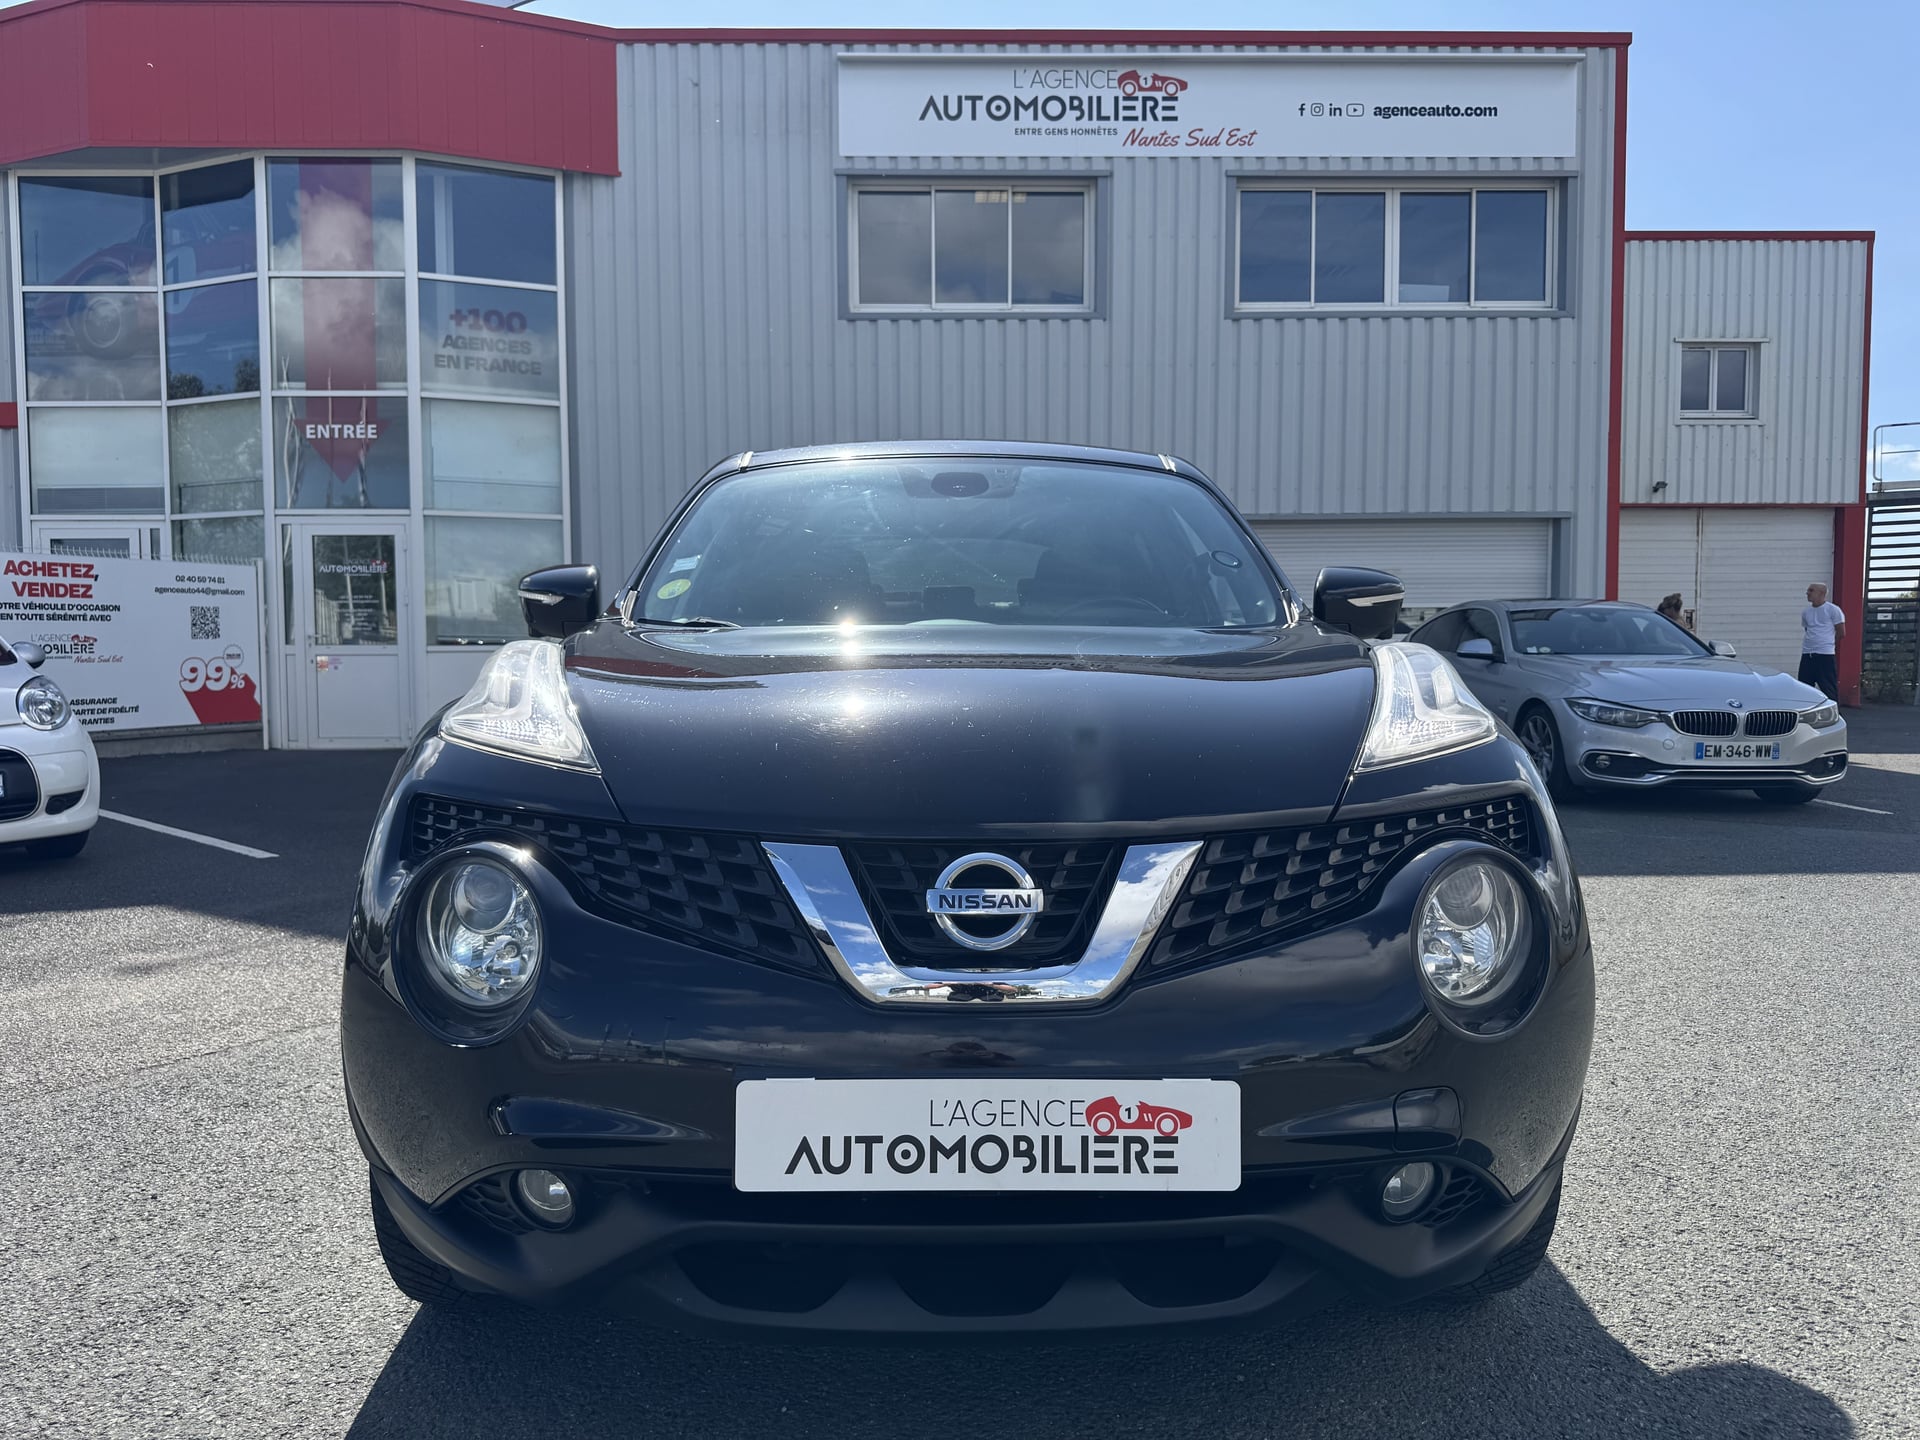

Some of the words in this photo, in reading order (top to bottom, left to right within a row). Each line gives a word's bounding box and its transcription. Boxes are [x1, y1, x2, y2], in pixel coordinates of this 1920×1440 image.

[1013, 69, 1118, 89] L'AGENCE
[1373, 105, 1498, 119] agenceauto.com
[1014, 127, 1042, 136] ENTRE
[1044, 127, 1068, 136] GENS
[1070, 125, 1118, 136] HONNÊTES
[1122, 128, 1180, 148] Nantes
[1185, 128, 1224, 147] Sud
[1225, 128, 1258, 147] Est
[449, 308, 527, 335] +100
[442, 334, 533, 355] AGENCES
[434, 354, 460, 370] EN
[464, 355, 542, 376] FRANCE
[305, 420, 378, 439] ENTRÉE
[11, 581, 93, 599] VENDEZ
[154, 587, 245, 596] agenceauto44@gmail.com
[21, 601, 67, 612] VÉHICULE
[67, 603, 121, 613] D'OCCASION
[14, 613, 45, 621] TOUTE
[46, 612, 88, 623] SÉRÉNITÉ
[89, 614, 112, 623] AVEC
[30, 633, 71, 643] L'AGENCE
[69, 696, 118, 706] ASSURANCE
[96, 707, 108, 715] DE
[108, 704, 140, 714] FIDÉLITÉ
[938, 893, 1032, 909] NISSAN
[929, 1099, 1086, 1127] L'AGENCE
